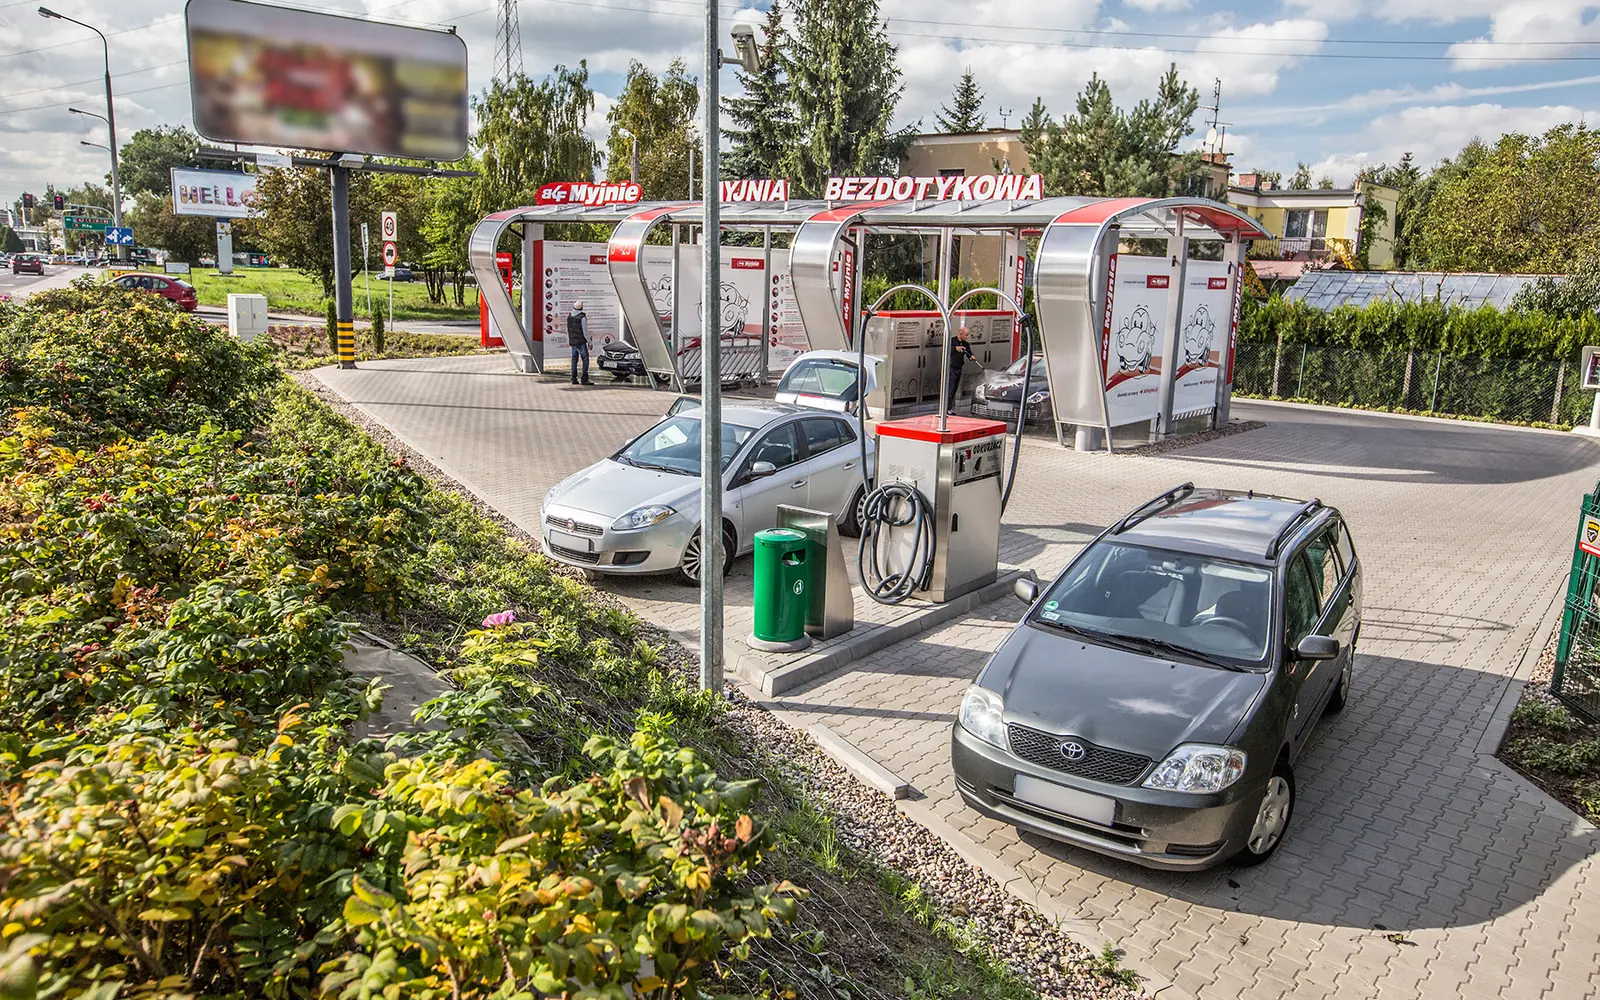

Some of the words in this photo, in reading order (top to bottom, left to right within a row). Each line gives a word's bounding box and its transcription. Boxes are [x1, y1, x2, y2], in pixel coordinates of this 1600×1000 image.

[568, 181, 639, 205] Myjnie
[719, 179, 788, 201] YJNIA
[824, 174, 1044, 201] BEZDOTYKOWA
[1104, 258, 1116, 329] Myjnie
[1233, 266, 1243, 323] Myjnie
